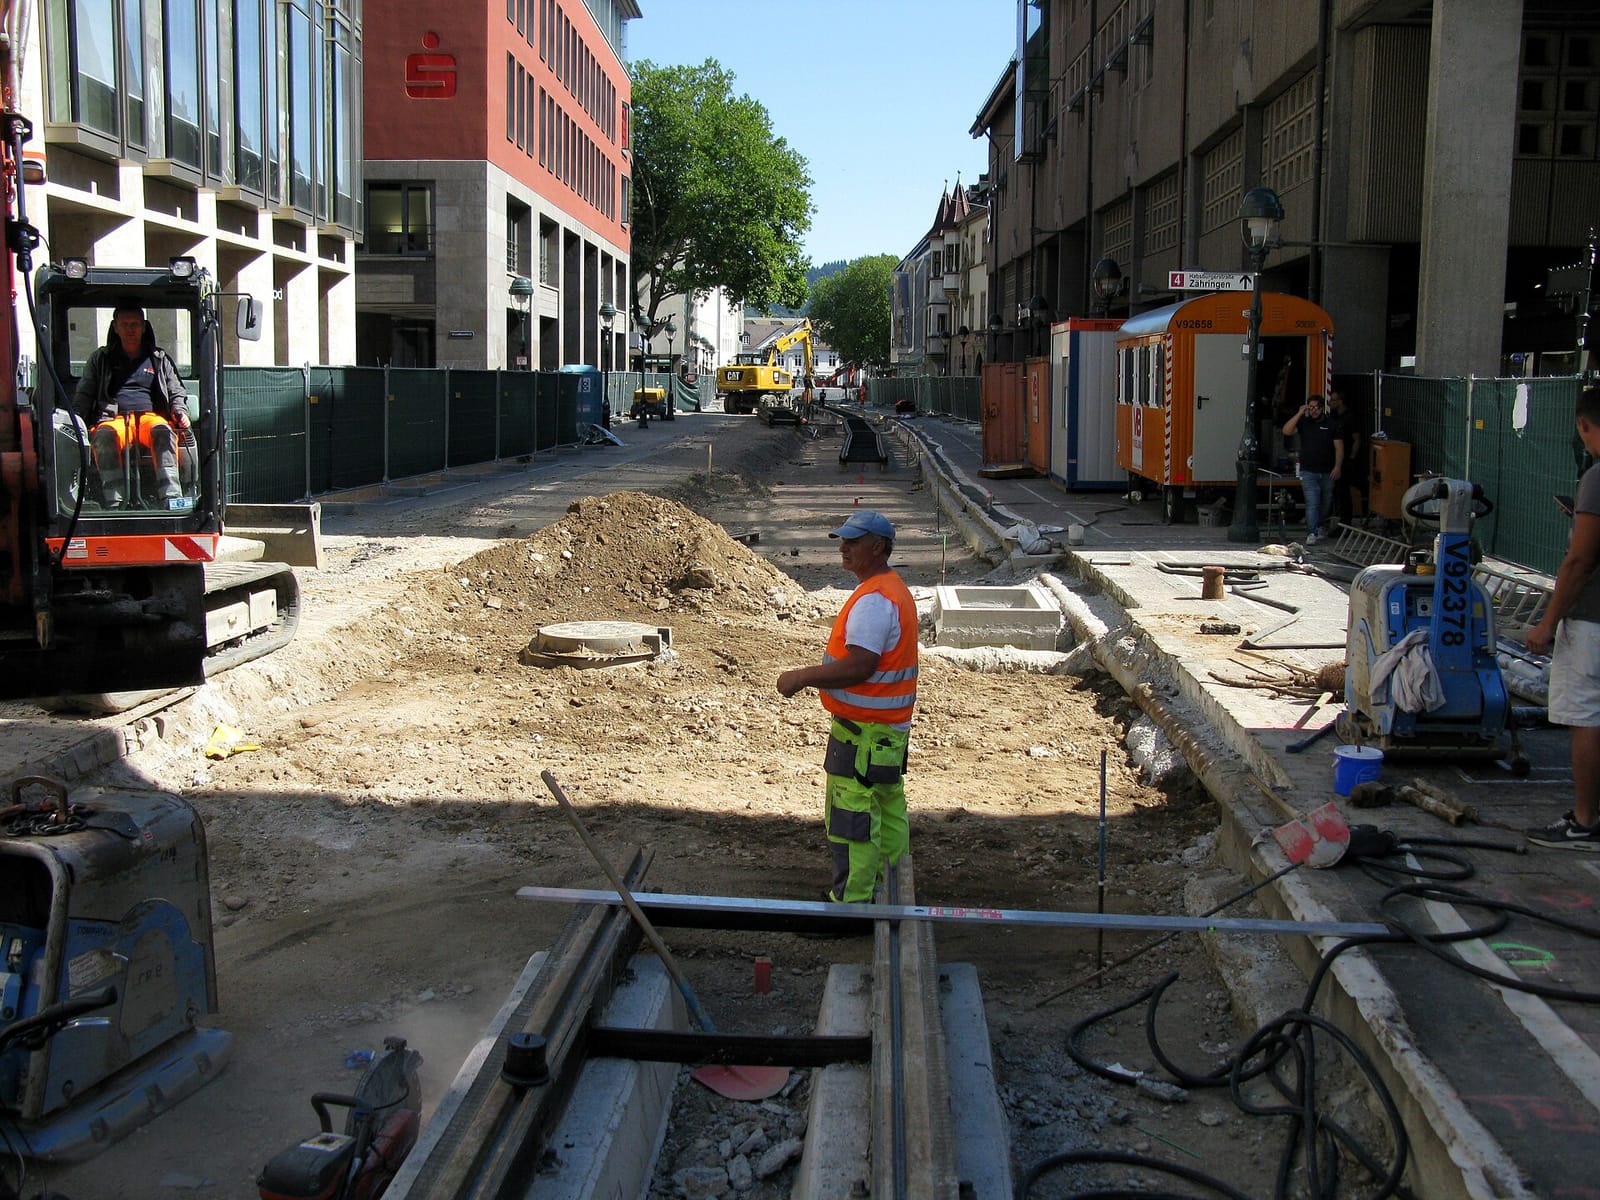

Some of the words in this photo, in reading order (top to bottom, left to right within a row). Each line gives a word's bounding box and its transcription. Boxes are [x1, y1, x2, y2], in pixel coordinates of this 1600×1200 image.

[1174, 274, 1181, 286] 4
[1189, 279, 1231, 289] Zähringen
[1176, 320, 1213, 329] V92658
[727, 371, 741, 381] CAT
[1441, 541, 1470, 647] V92378
